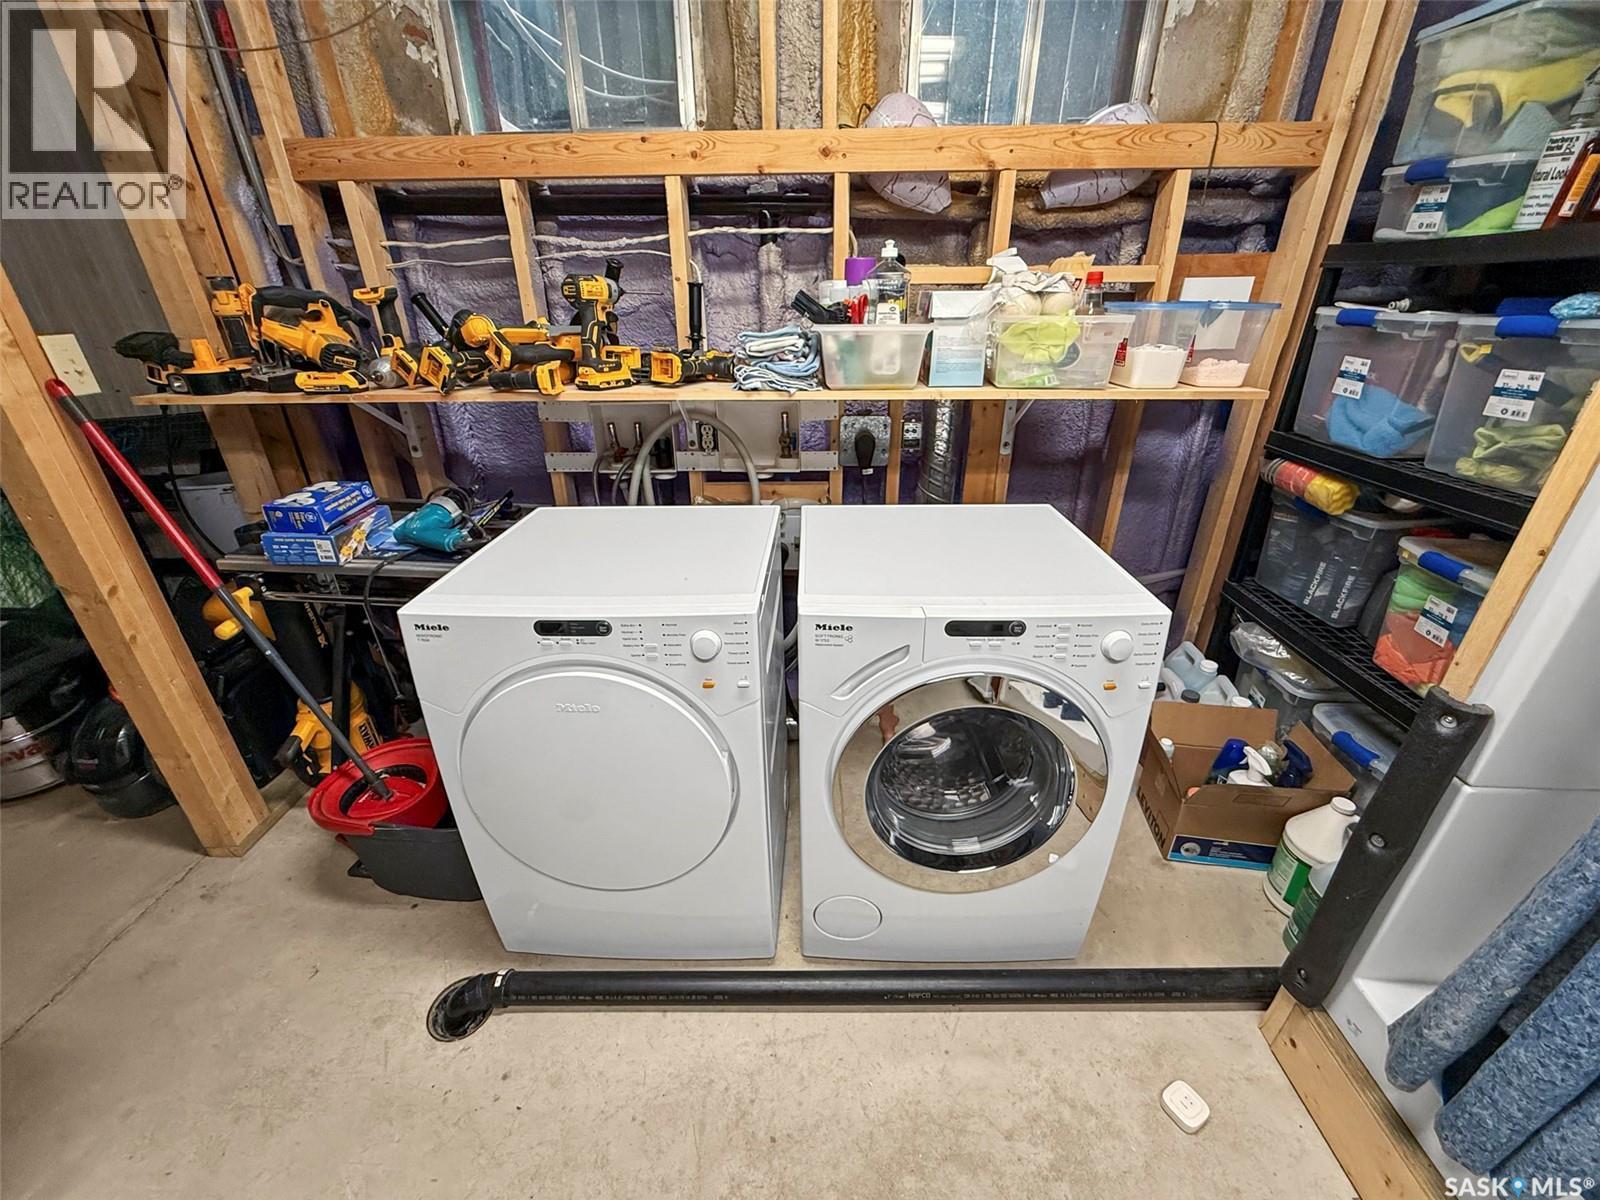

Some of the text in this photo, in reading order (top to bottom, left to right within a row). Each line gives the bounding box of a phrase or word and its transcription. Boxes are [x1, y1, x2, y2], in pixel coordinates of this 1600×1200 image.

[1303, 561, 1327, 605] BLACKFIRE
[1331, 575, 1356, 619] BLACKFIRE
[414, 623, 450, 631] Miele
[815, 623, 853, 631] Miele
[555, 703, 601, 713] Miele
[1136, 784, 1167, 849] LEVITON
